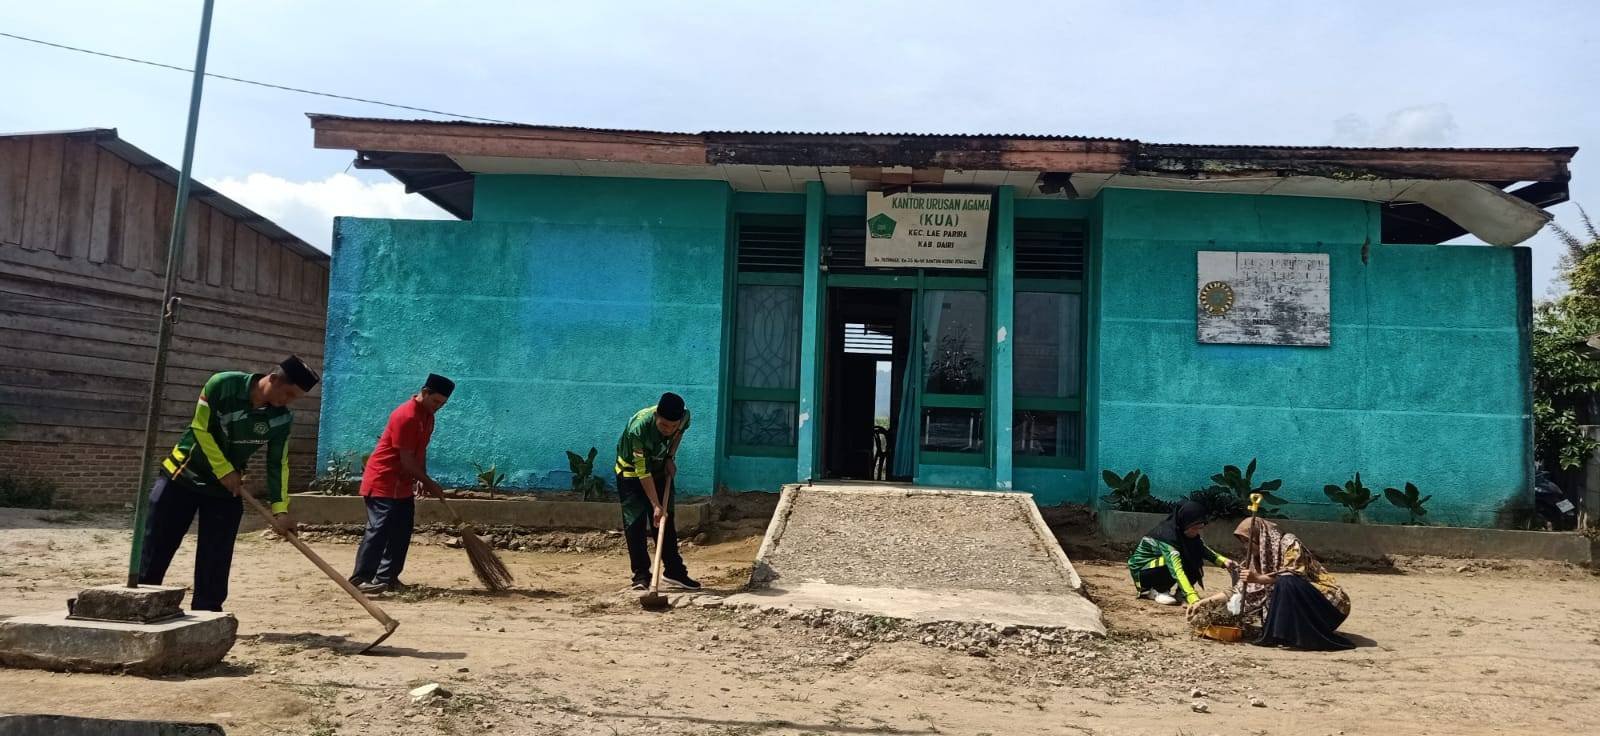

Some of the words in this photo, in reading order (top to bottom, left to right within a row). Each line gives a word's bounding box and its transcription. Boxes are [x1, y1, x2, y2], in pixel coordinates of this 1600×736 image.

[892, 197, 924, 209] KANTOR
[926, 198, 961, 210] URUSAN
[962, 199, 990, 211] AGAMA
[919, 214, 959, 227] (KUA)
[943, 230, 968, 238] PARIRA
[936, 241, 954, 249] DAIRI
